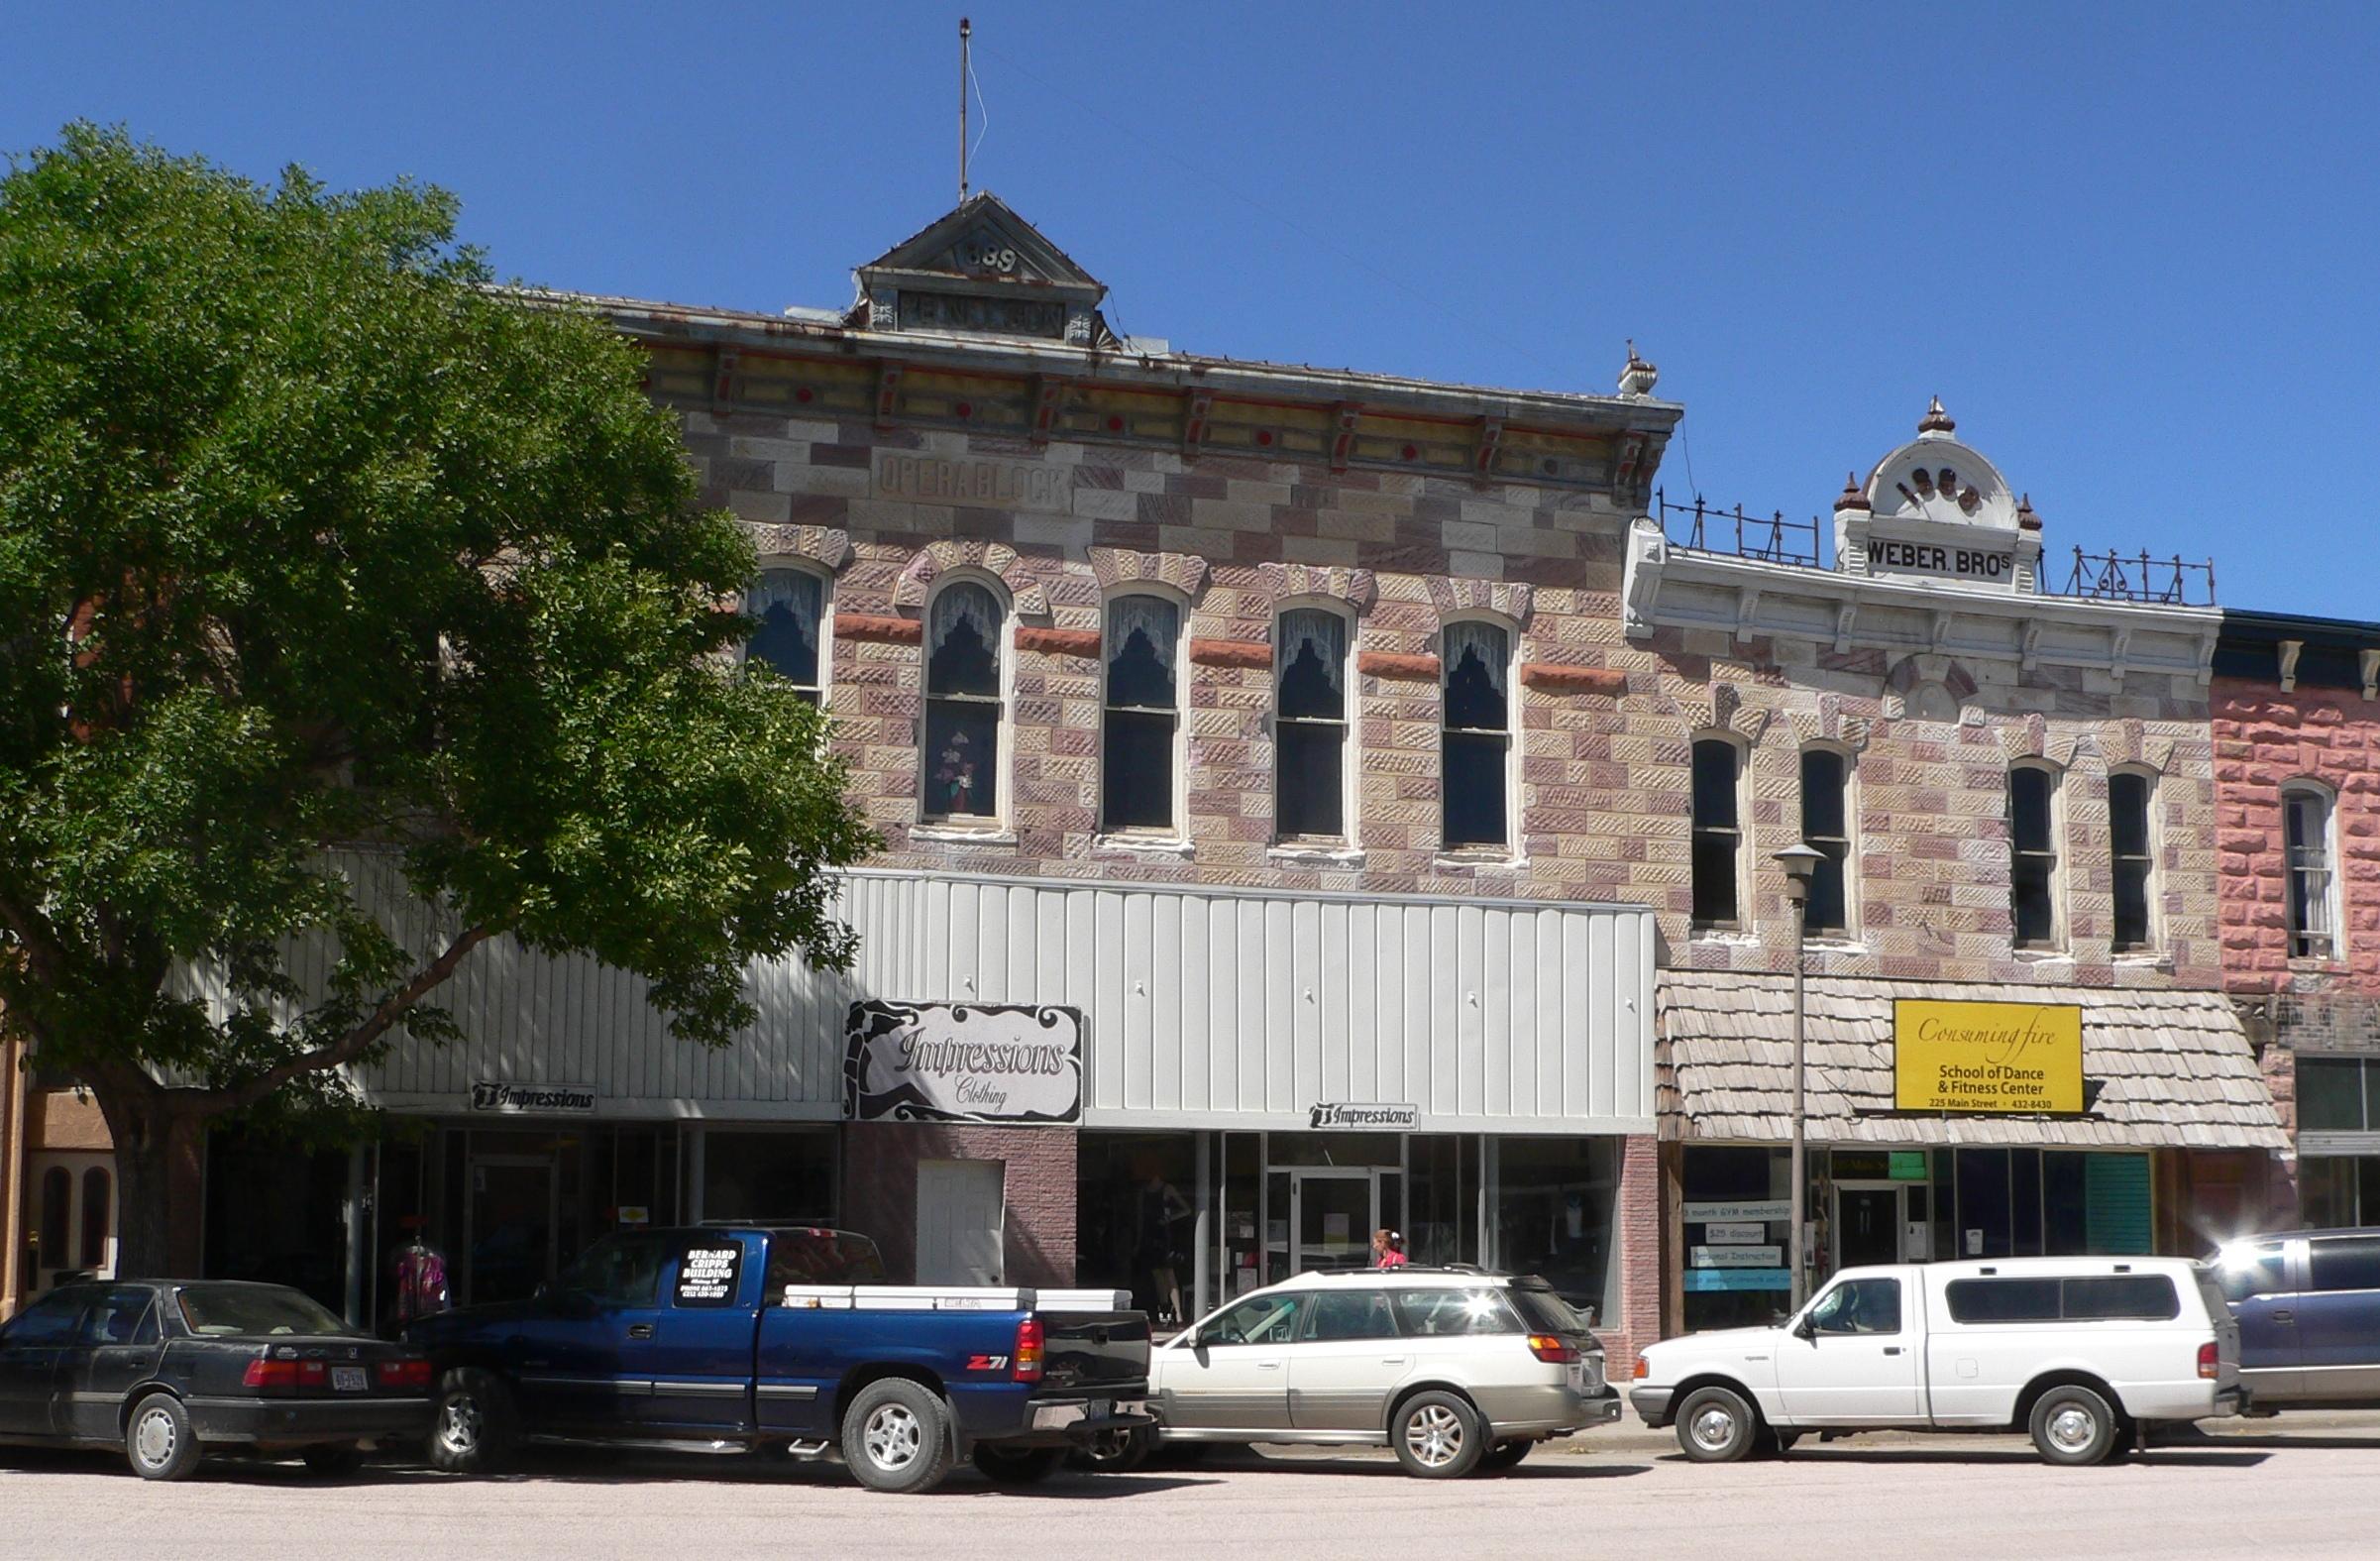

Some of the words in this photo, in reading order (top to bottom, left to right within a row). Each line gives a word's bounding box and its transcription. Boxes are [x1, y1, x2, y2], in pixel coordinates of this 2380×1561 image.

[880, 455, 969, 498] OPERA
[975, 461, 1065, 504] BLOCK
[1918, 1017, 2020, 1064] Consuming
[895, 1027, 1065, 1076] Impressions
[1939, 1064, 1984, 1079] School
[1988, 1065, 2001, 1079] of
[2003, 1065, 2044, 1080] Dance
[499, 1085, 595, 1109] Impressions
[954, 1074, 1008, 1113] Clothing
[1938, 1080, 1948, 1093] &
[1952, 1081, 1998, 1095] Fitness
[2001, 1082, 2044, 1095] Center
[1929, 1098, 1945, 1107] 225
[1947, 1098, 1969, 1107] Main
[1972, 1099, 1998, 1108] Street
[1333, 1105, 1415, 1128] Impressions
[682, 1268, 732, 1279] BUILDING
[691, 1259, 729, 1269] CRIPPS
[967, 1355, 1009, 1370] Z71
